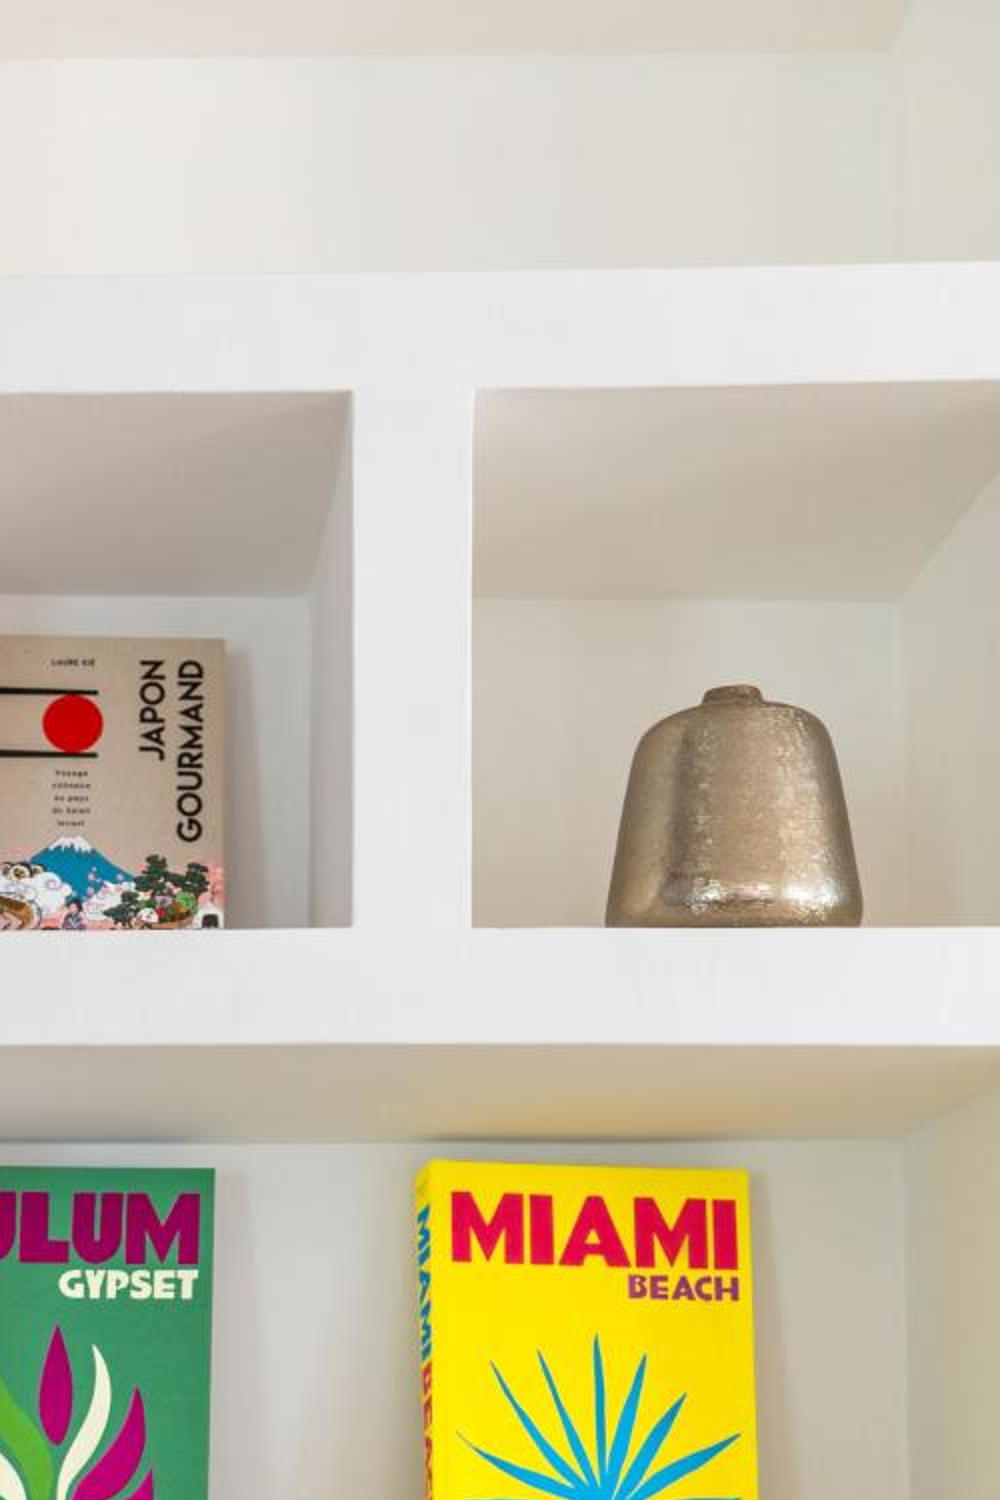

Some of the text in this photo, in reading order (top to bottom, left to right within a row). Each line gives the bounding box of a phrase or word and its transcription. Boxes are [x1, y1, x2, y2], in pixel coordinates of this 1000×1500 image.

[139, 660, 165, 761] JAPON
[177, 660, 204, 842] GOURMAND
[451, 1191, 738, 1270] MIAMI
[58, 1269, 199, 1300] GYPSET
[628, 1274, 740, 1302] BEACH
